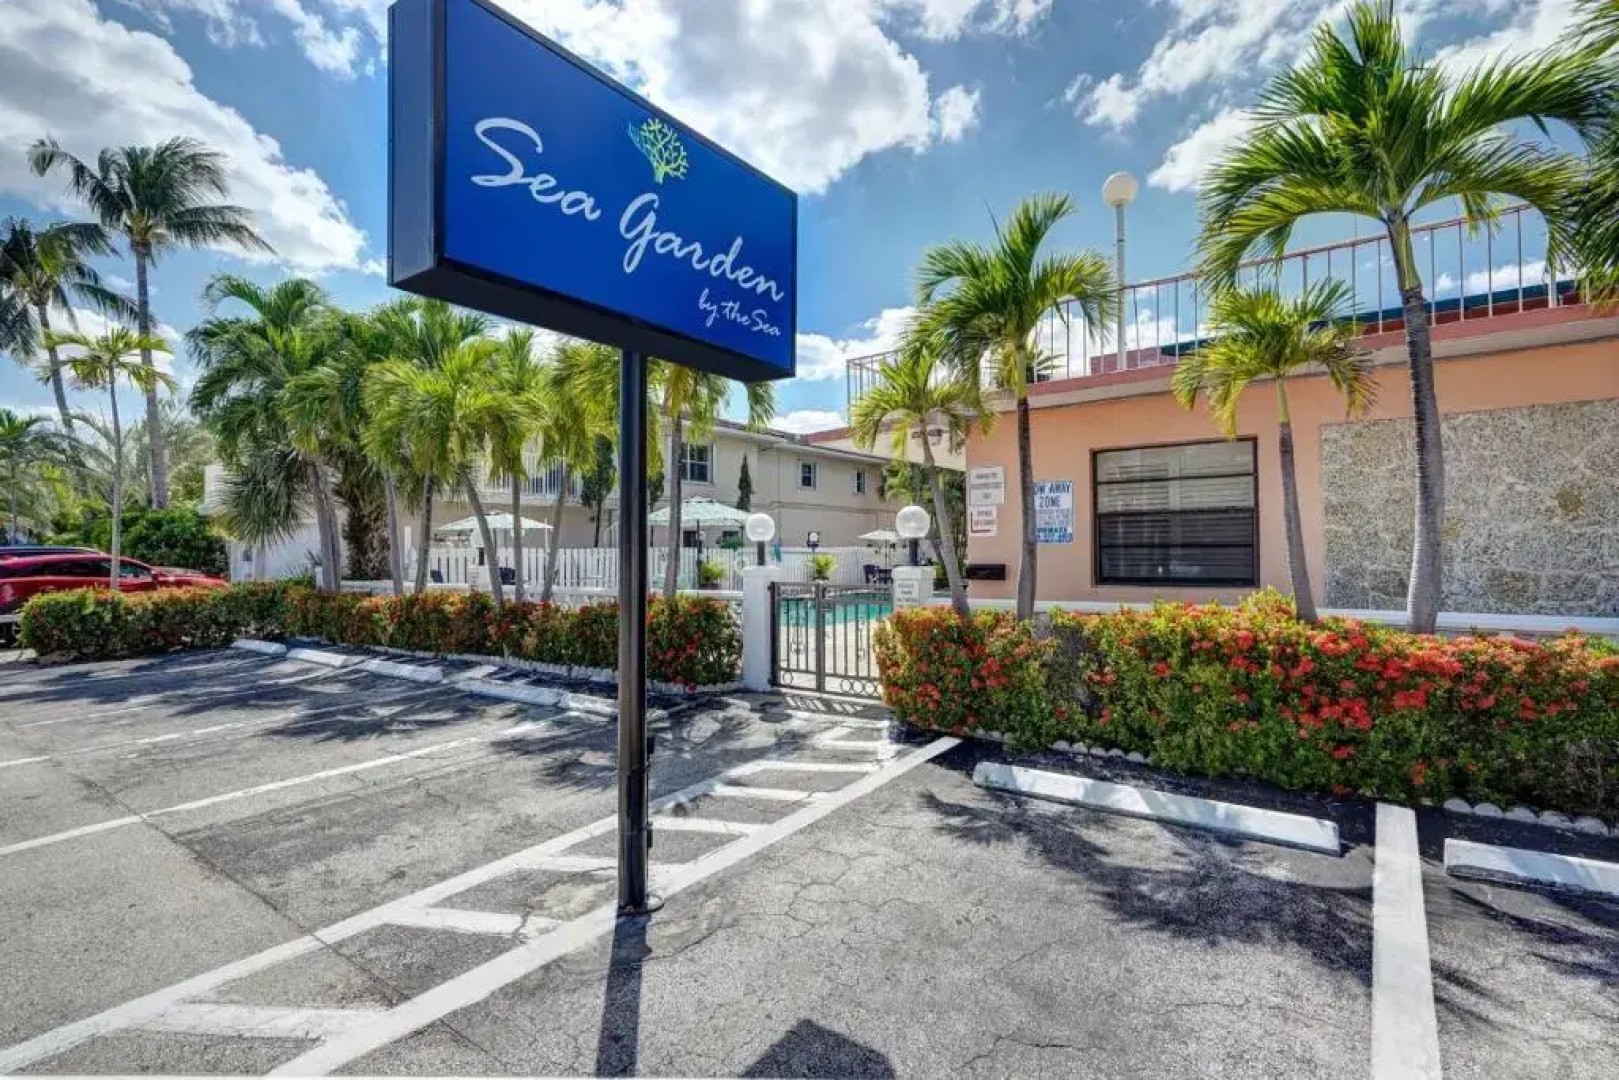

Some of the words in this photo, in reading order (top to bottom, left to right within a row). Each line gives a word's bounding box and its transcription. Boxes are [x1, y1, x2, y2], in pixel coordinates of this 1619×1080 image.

[471, 116, 601, 221] Sea
[619, 192, 784, 302] Garden
[698, 287, 718, 328] by
[720, 299, 751, 325] the
[751, 309, 781, 336] Sea
[1039, 496, 1062, 508] ZONE
[1049, 482, 1072, 494] AWAY
